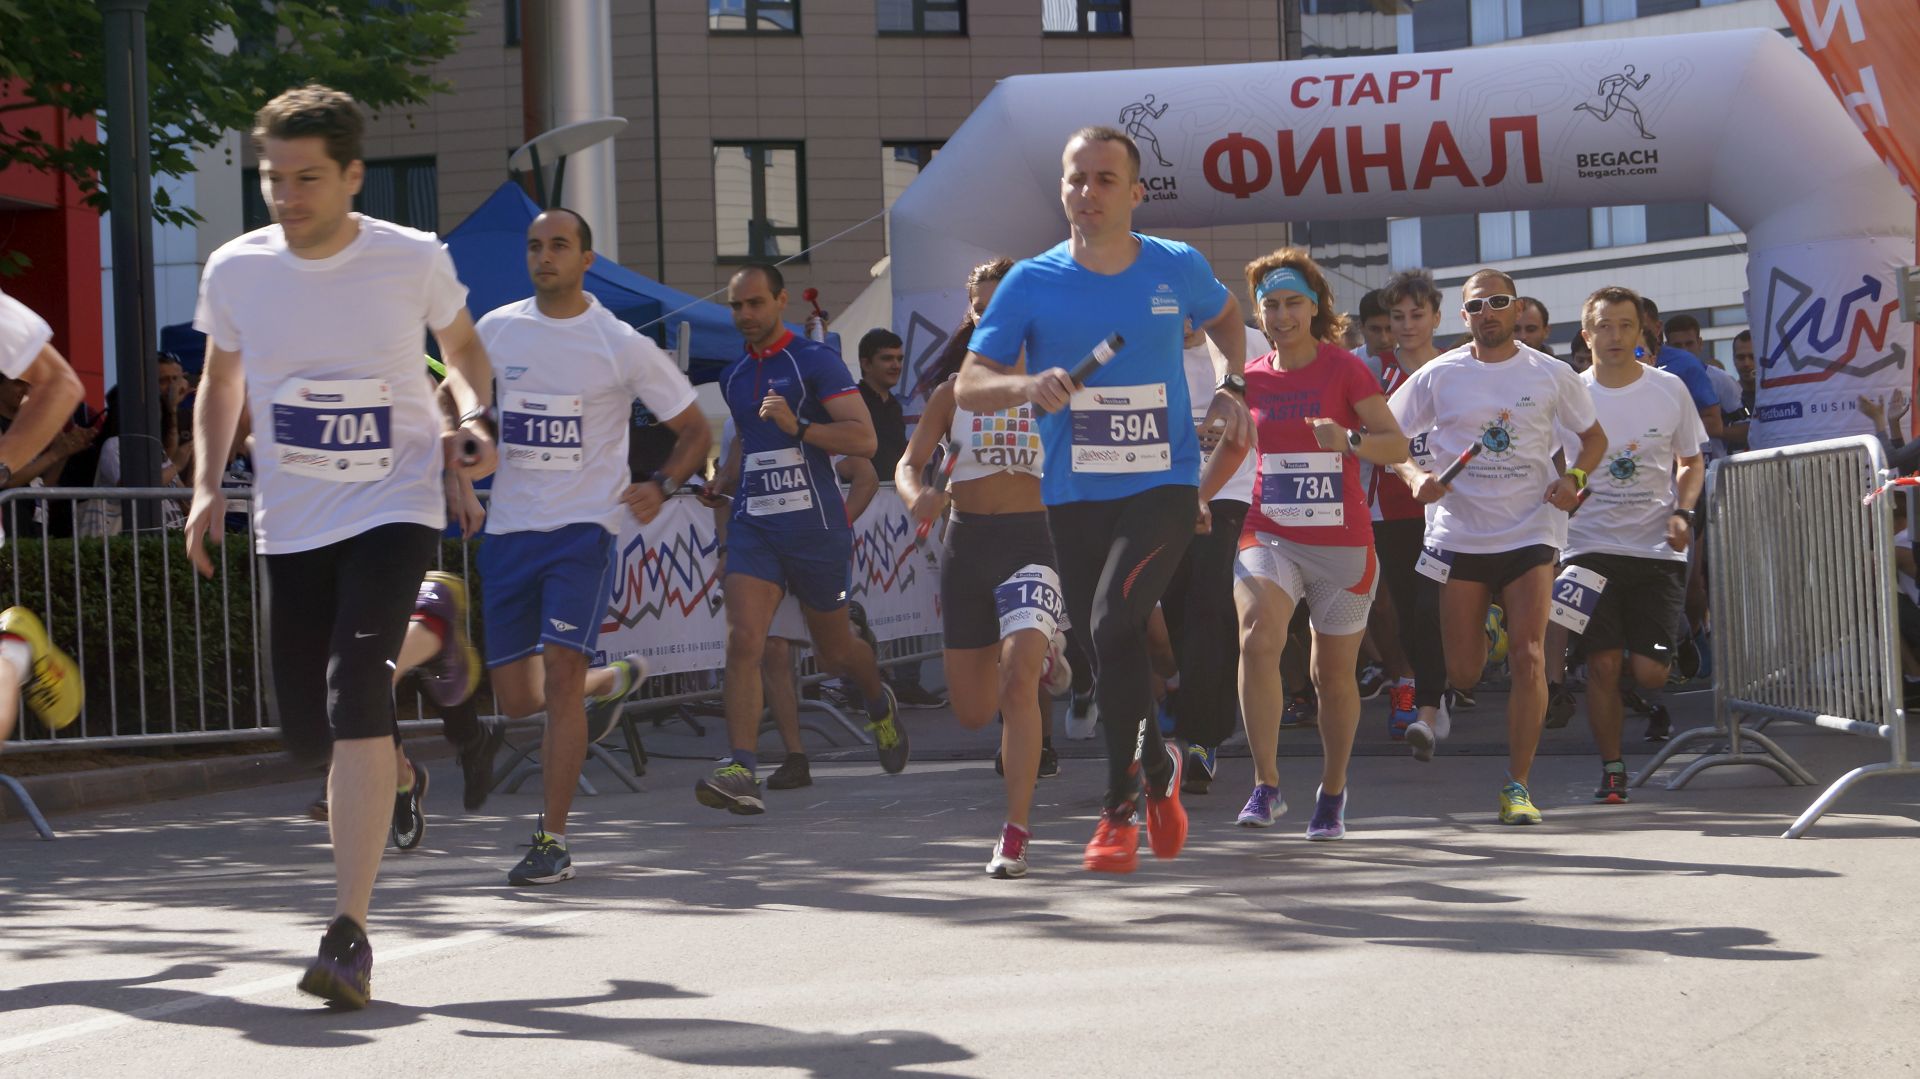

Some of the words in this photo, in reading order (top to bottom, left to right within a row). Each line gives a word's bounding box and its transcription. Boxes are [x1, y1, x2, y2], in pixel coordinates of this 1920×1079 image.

[1290, 67, 1453, 109] СТАРТ
[1203, 115, 1544, 199] ФИНАЛ
[1577, 149, 1658, 168] BEGACH
[1578, 167, 1657, 179] begach.com
[1152, 191, 1178, 200] club
[316, 412, 381, 445] 70A
[524, 418, 580, 443] 119A
[1110, 412, 1160, 441] 59A
[971, 447, 1038, 466] raw
[760, 467, 808, 492] 104A
[1293, 476, 1335, 500] 73A
[1017, 583, 1062, 619] 143A
[1557, 582, 1584, 608] 2A
